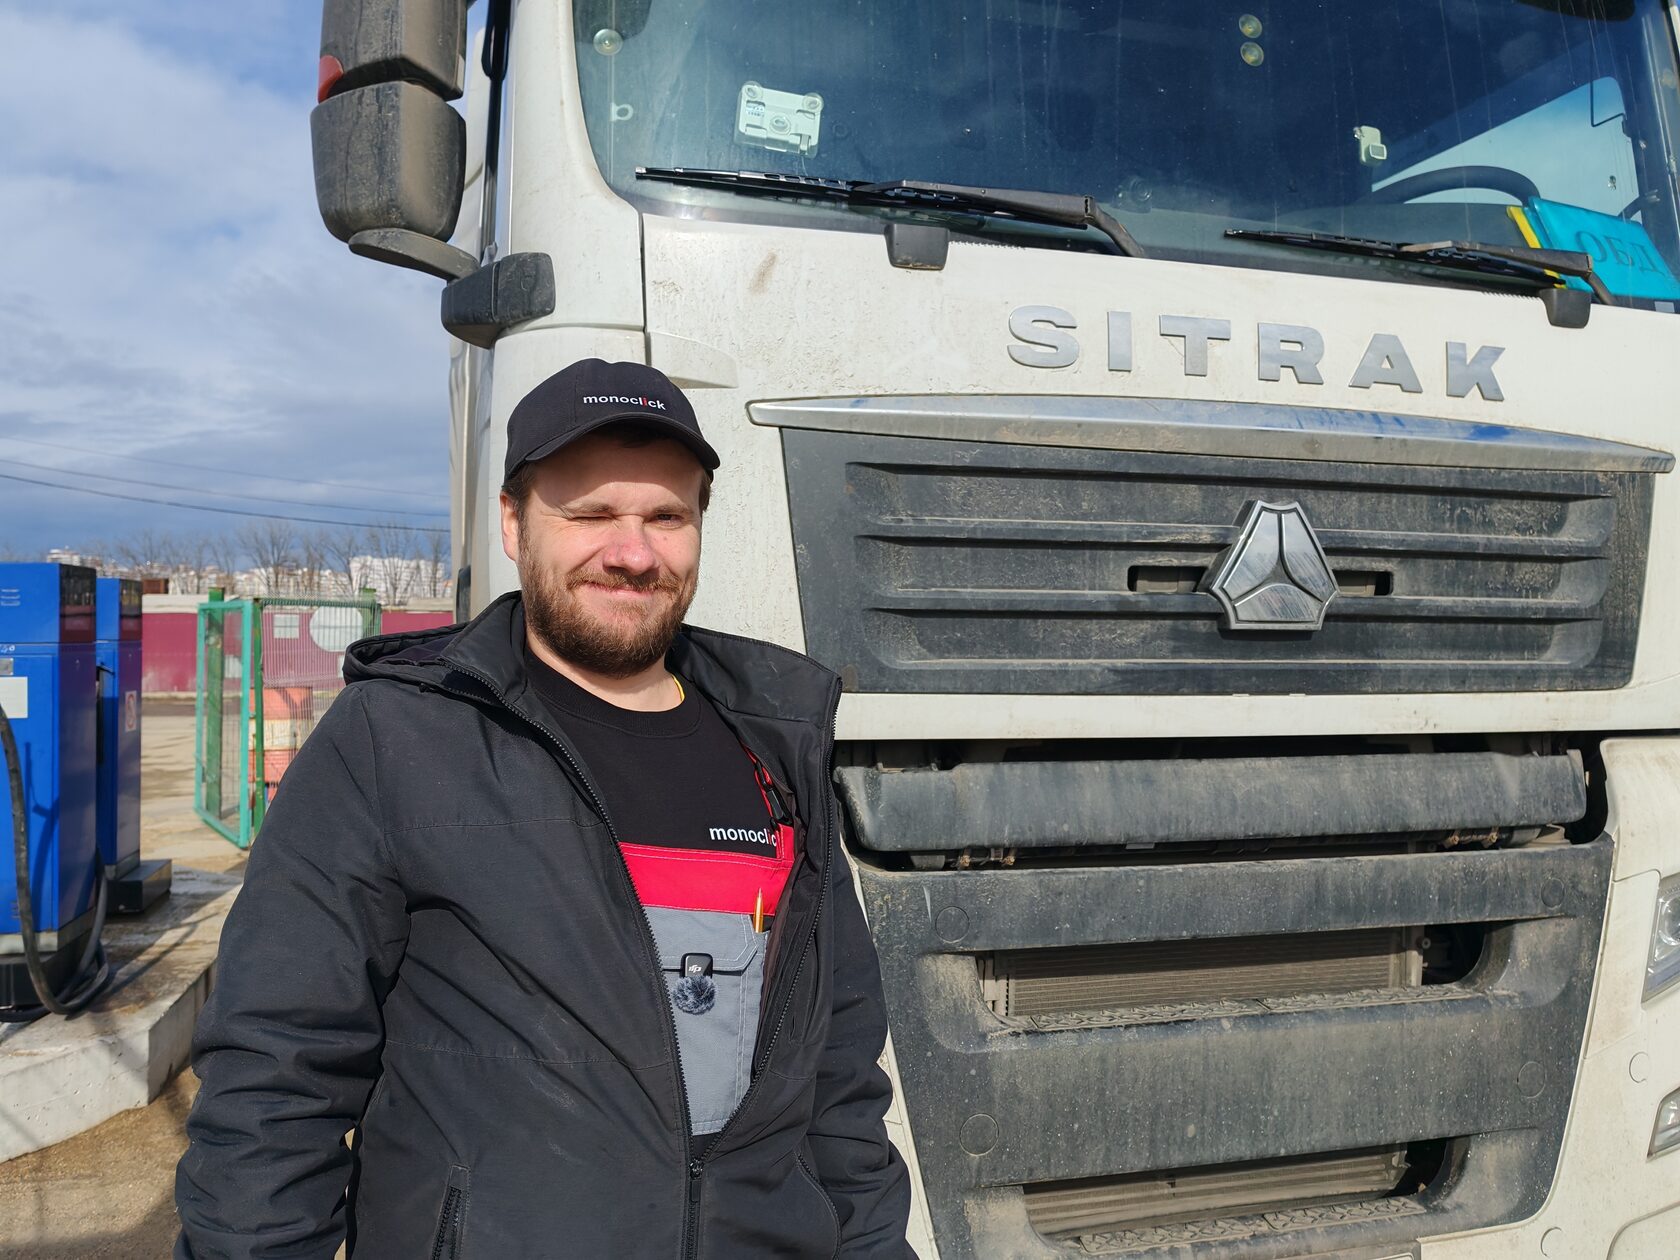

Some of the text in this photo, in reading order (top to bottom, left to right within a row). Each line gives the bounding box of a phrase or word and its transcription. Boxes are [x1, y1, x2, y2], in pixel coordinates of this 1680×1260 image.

[1006, 304, 1506, 402] SITRAK
[583, 394, 666, 411] monoclick
[708, 827, 778, 847] monoclic
